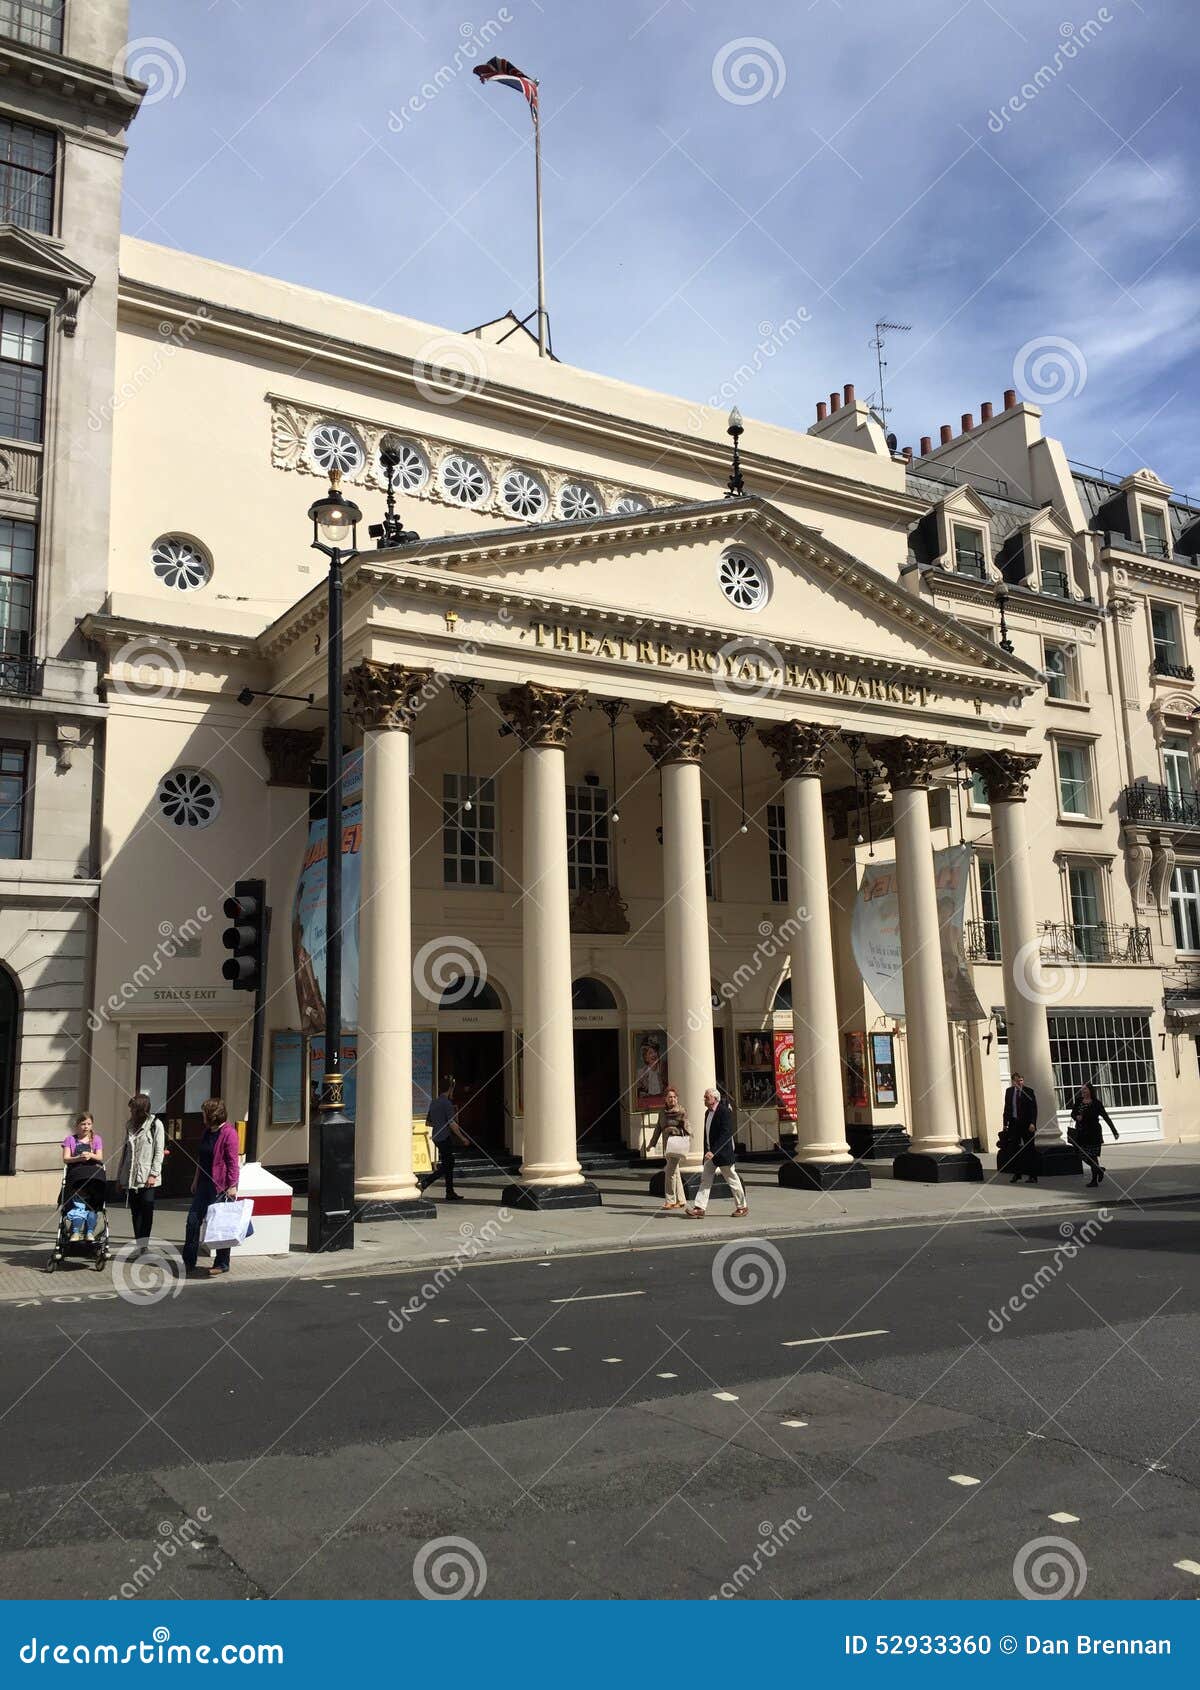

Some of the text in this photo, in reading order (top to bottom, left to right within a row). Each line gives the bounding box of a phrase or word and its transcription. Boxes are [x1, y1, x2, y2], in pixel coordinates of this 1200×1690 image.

[530, 621, 930, 707] THEATRE ROYAL HAYMARKET
[154, 990, 217, 1000] STALLS EXIT
